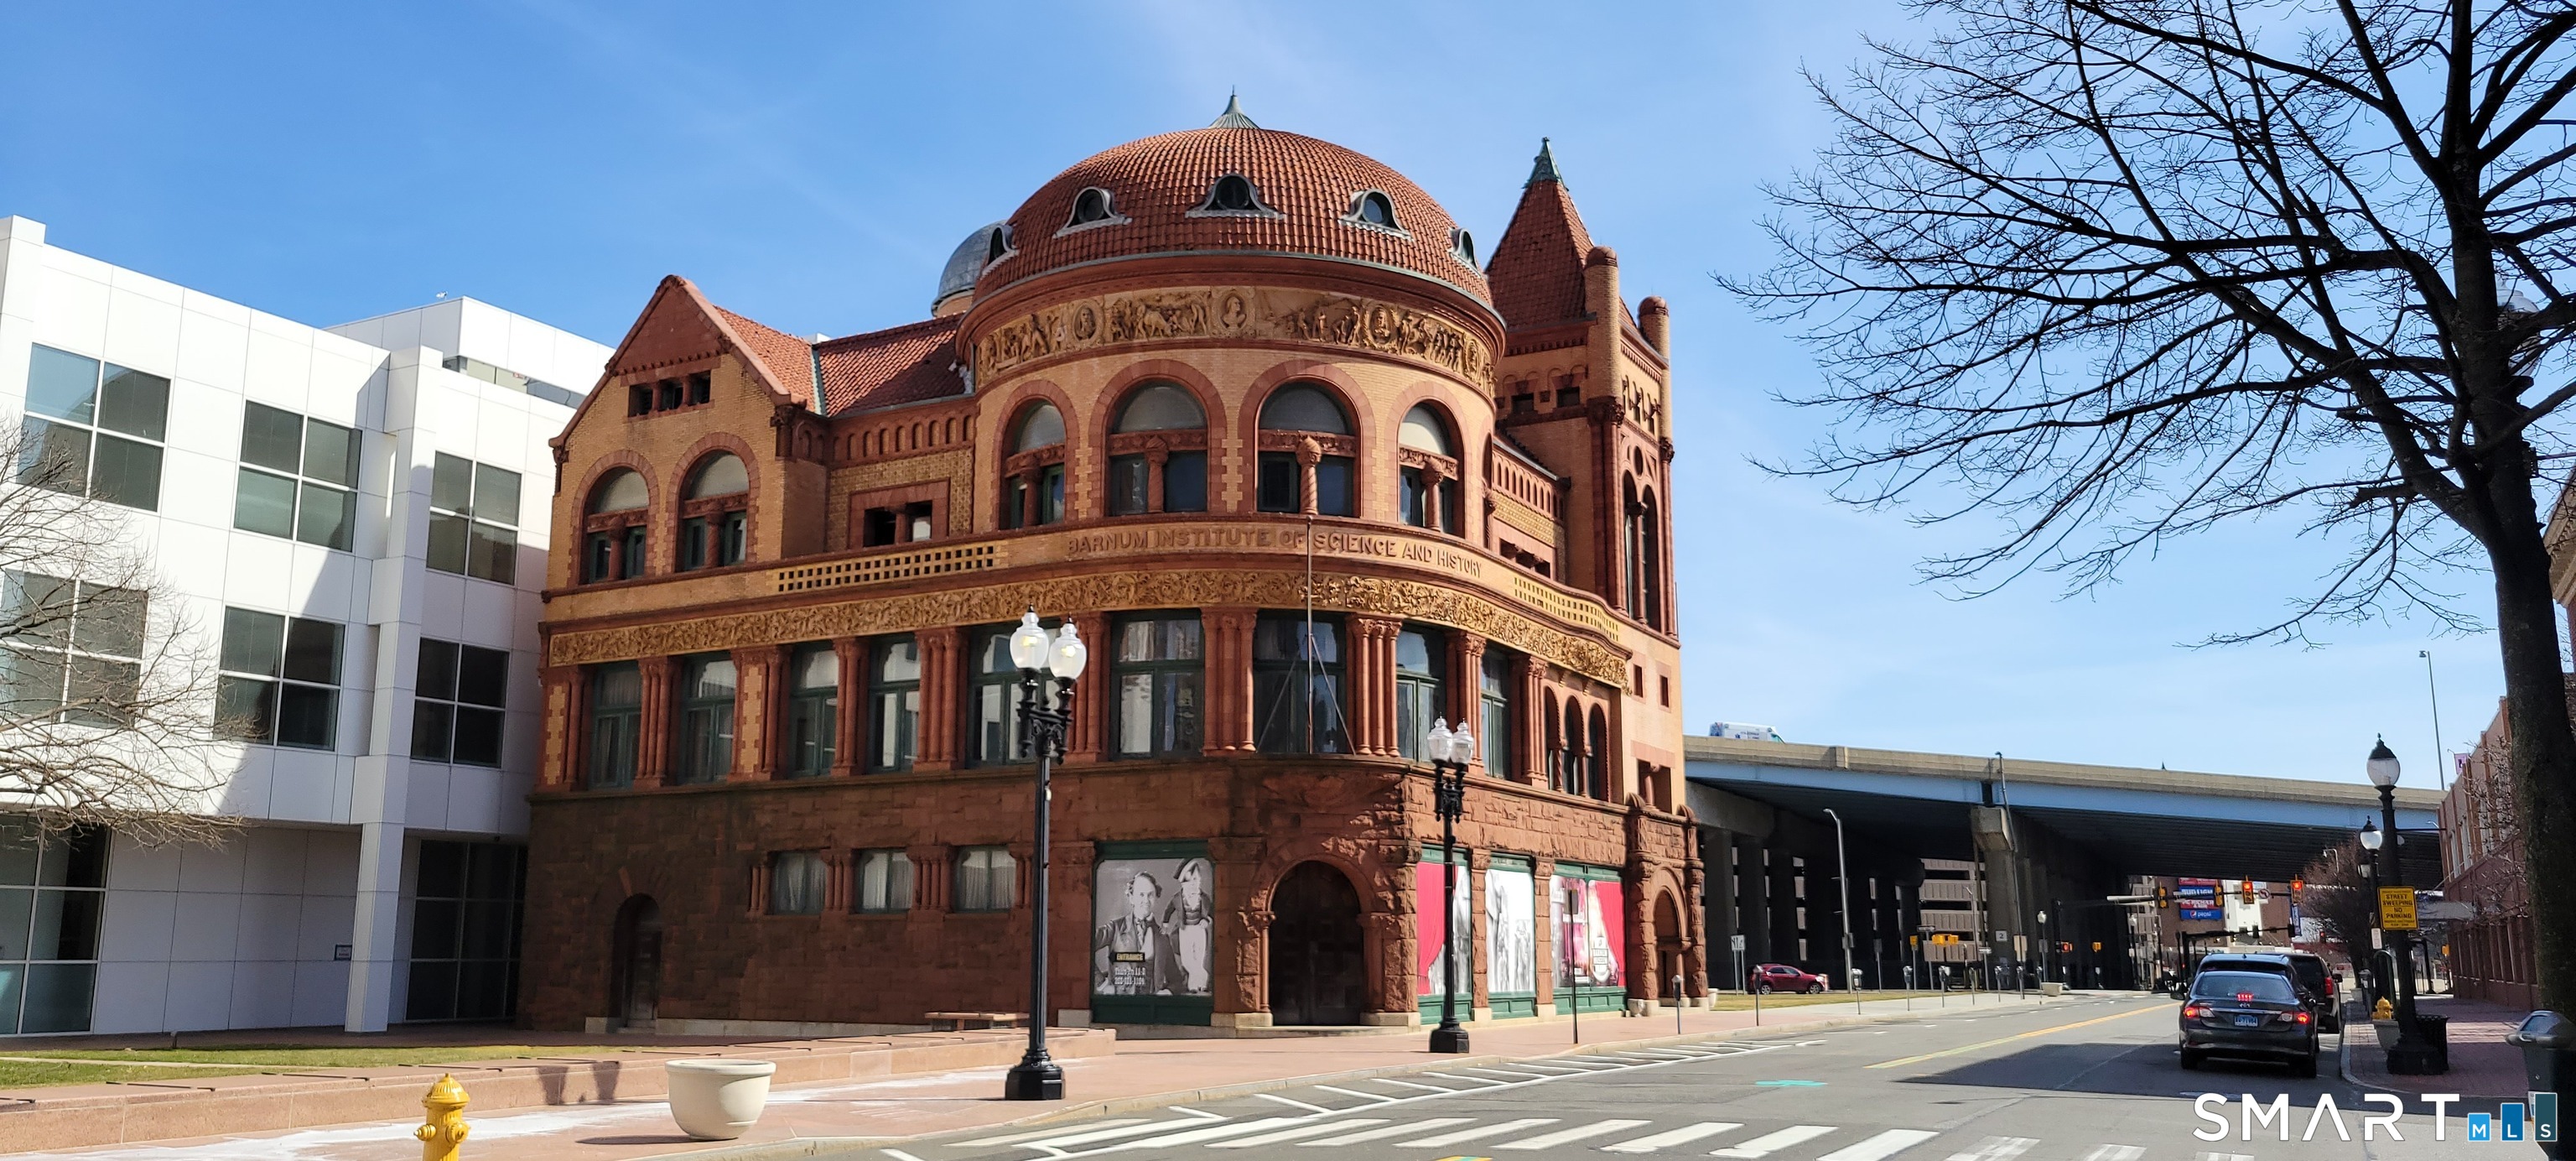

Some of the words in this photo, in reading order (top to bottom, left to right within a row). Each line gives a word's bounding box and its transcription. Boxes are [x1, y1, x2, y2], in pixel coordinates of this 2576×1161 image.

[1068, 530, 1148, 554] BARNUM
[1156, 528, 1271, 548] INSTITUTE
[1279, 529, 1306, 549] OF
[1313, 531, 1397, 557] SCIENCE
[1402, 542, 1433, 563] AND
[1437, 549, 1483, 578] HISTORY
